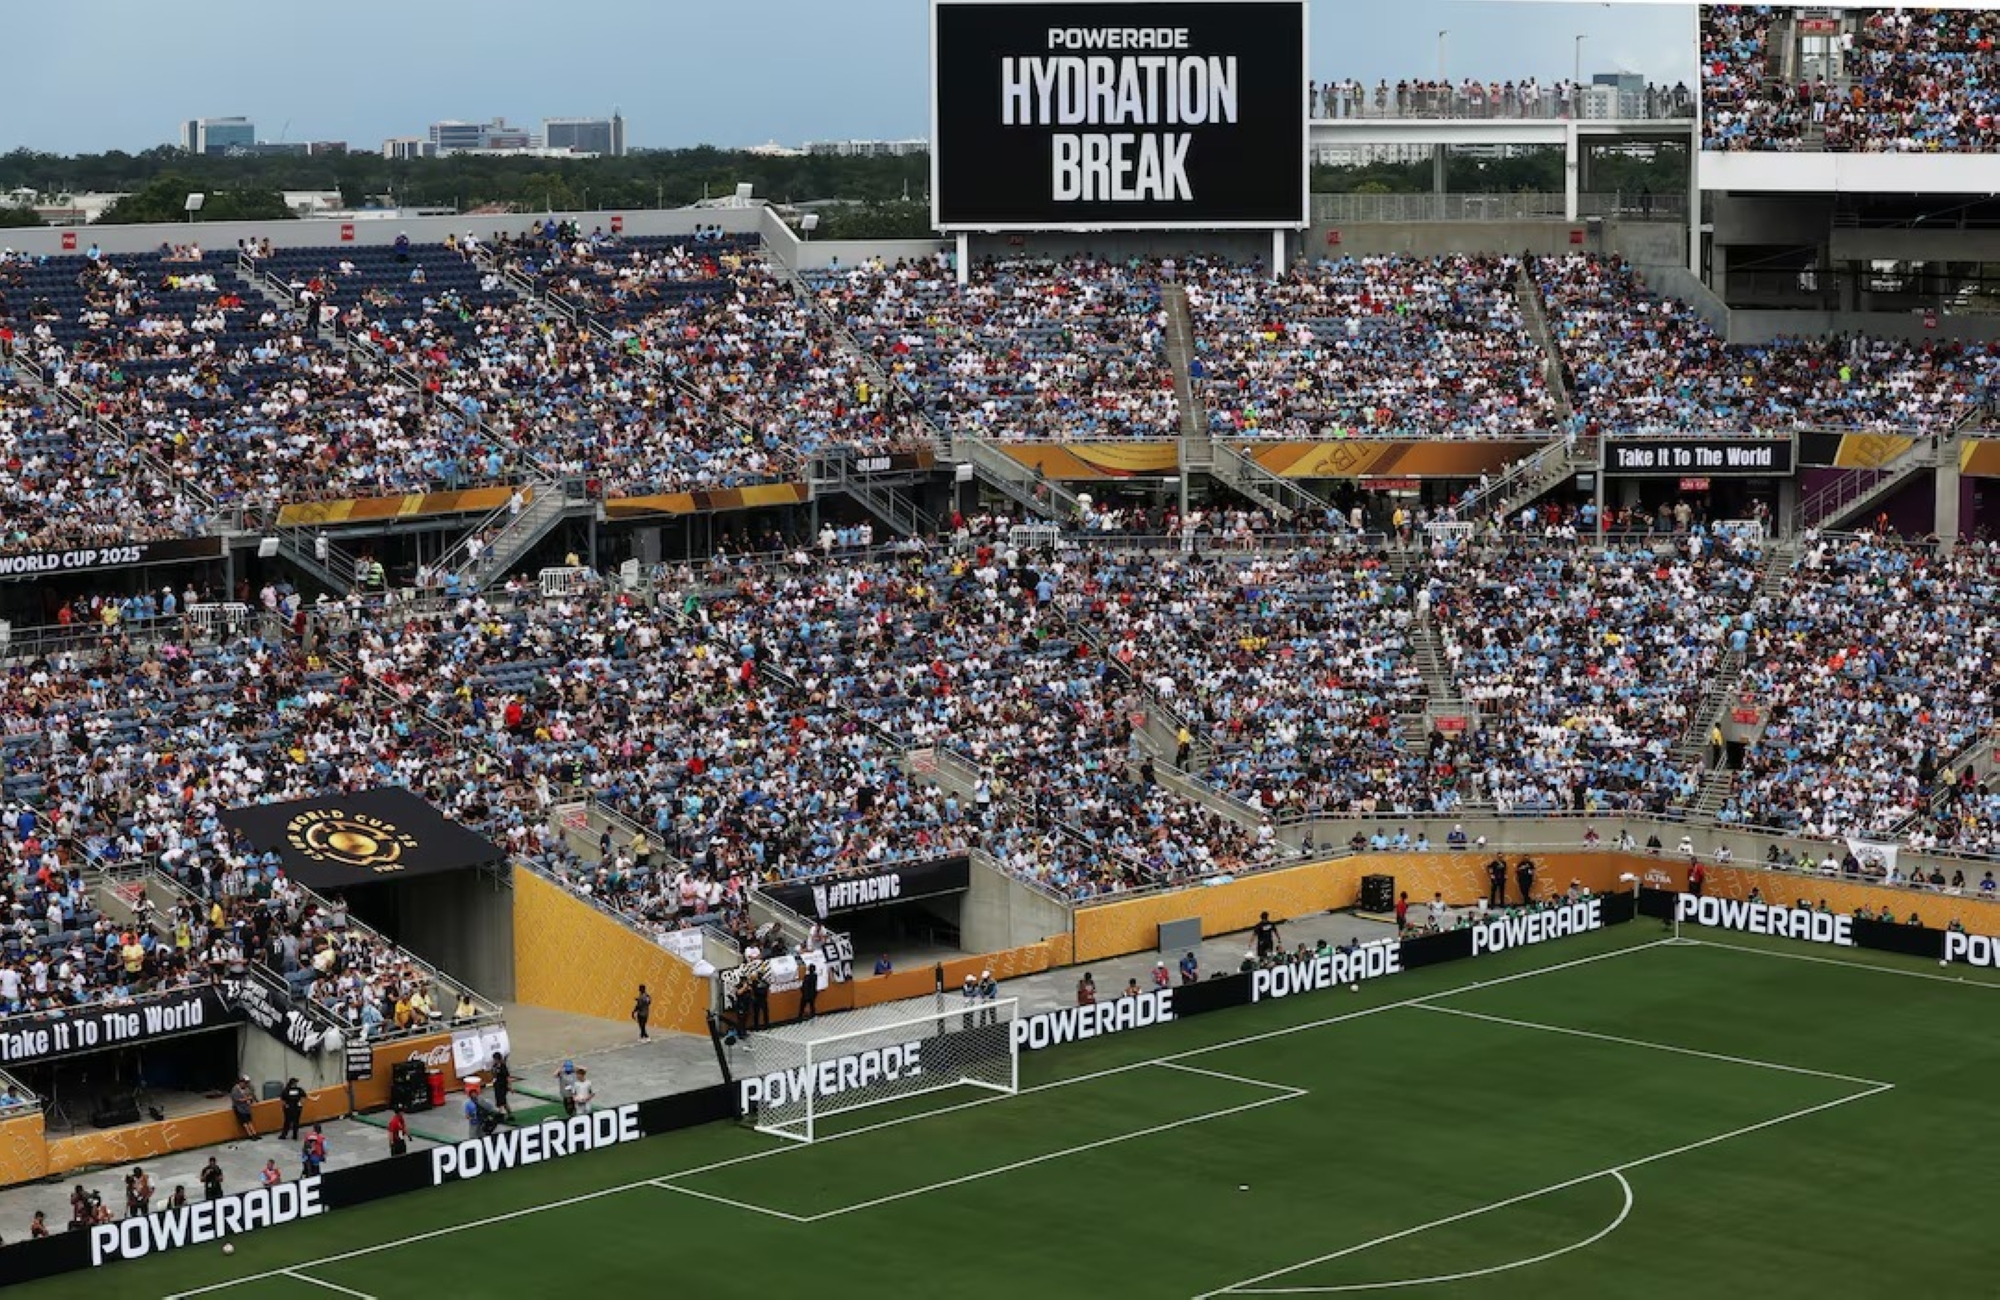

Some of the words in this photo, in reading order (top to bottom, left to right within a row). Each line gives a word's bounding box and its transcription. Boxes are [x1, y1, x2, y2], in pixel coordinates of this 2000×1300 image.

[1048, 28, 1189, 49] POWERADE
[1002, 55, 1238, 125] HYDRATION
[1052, 133, 1193, 201] BREAK
[1617, 448, 1653, 466] Take
[1657, 448, 1669, 466] It
[1673, 448, 1691, 466] To
[1695, 447, 1722, 466] The
[1726, 447, 1771, 466] World
[0, 553, 59, 574] WORLD
[63, 550, 97, 568] CUP
[287, 809, 345, 833] WORLD
[354, 814, 396, 832] CUP
[829, 873, 900, 908] #FIFACWC
[1678, 892, 1853, 946] POWERADE
[1472, 898, 1600, 956] POWERADE
[1252, 943, 1400, 1003] POWERADE
[0, 1029, 49, 1061] Take
[54, 1022, 70, 1050] It
[73, 1019, 98, 1047] To
[102, 1012, 140, 1041] The
[144, 998, 203, 1034] World
[1010, 988, 1173, 1054] POWERADE
[741, 1041, 922, 1114] POWERADE
[431, 1103, 640, 1185] POWERADE
[91, 1176, 322, 1266] POWERADE
